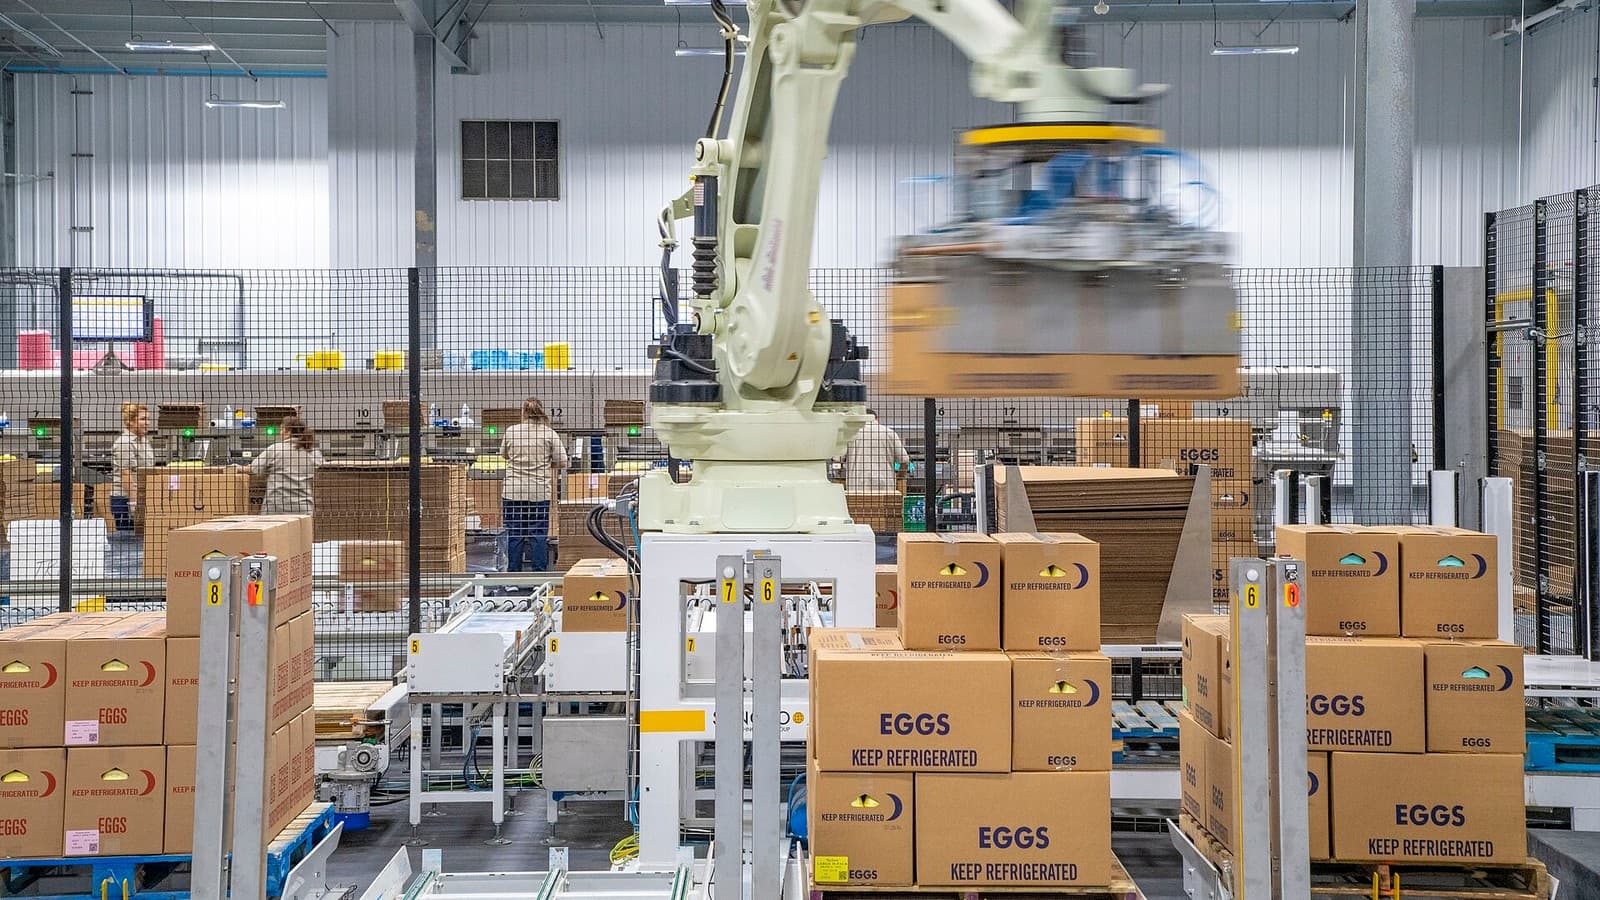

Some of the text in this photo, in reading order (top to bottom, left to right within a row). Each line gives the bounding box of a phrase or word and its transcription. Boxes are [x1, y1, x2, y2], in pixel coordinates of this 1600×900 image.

[356, 408, 369, 418] 10
[550, 408, 563, 417] 12
[1003, 407, 1016, 416] 17
[1215, 408, 1228, 416] 19
[1180, 449, 1219, 460] EGGS
[1328, 570, 1370, 578] REFRIGERATED
[1410, 572, 1470, 580] KEEP REFRIGERATED
[911, 581, 971, 589] KEEP REFRIGERATED
[1011, 583, 1071, 591] KEEP REFRIGERATED
[210, 585, 220, 604] 8
[725, 583, 733, 601] 7
[763, 581, 771, 601] 6
[1248, 587, 1256, 607] 6
[1340, 621, 1366, 631] EGGS
[1437, 624, 1464, 633] EGGS
[939, 635, 965, 645] EGGS
[1039, 637, 1066, 646] EGGS
[412, 641, 417, 653] 5
[551, 640, 556, 652] 6
[688, 639, 694, 652] 7
[0, 681, 39, 689] FRIGERATED
[91, 680, 138, 688] REFRIGERATED
[1433, 684, 1495, 693] KEEP REFRIGERATED
[1019, 700, 1081, 708] KEEP REFRIGERATED
[99, 708, 127, 725] EGGS
[881, 713, 949, 736] EGGS
[1307, 729, 1391, 747] REFRIGERATED
[1463, 738, 1490, 748] EGGS
[853, 749, 977, 767] KEEP REFRIGERATED
[1048, 756, 1076, 766] EGGS
[91, 789, 138, 797] REFRIGERATED
[173, 786, 189, 794] KEEP
[822, 814, 884, 822] KEEP REFRIGERATED
[1396, 805, 1465, 827] EGGS
[99, 817, 126, 834] EGGS
[979, 827, 1049, 850] EGGS
[1369, 839, 1493, 858] KEEP REFRIGERATED
[849, 870, 877, 880] EGGS
[951, 864, 1077, 881] KEEP REFRIGERATED
